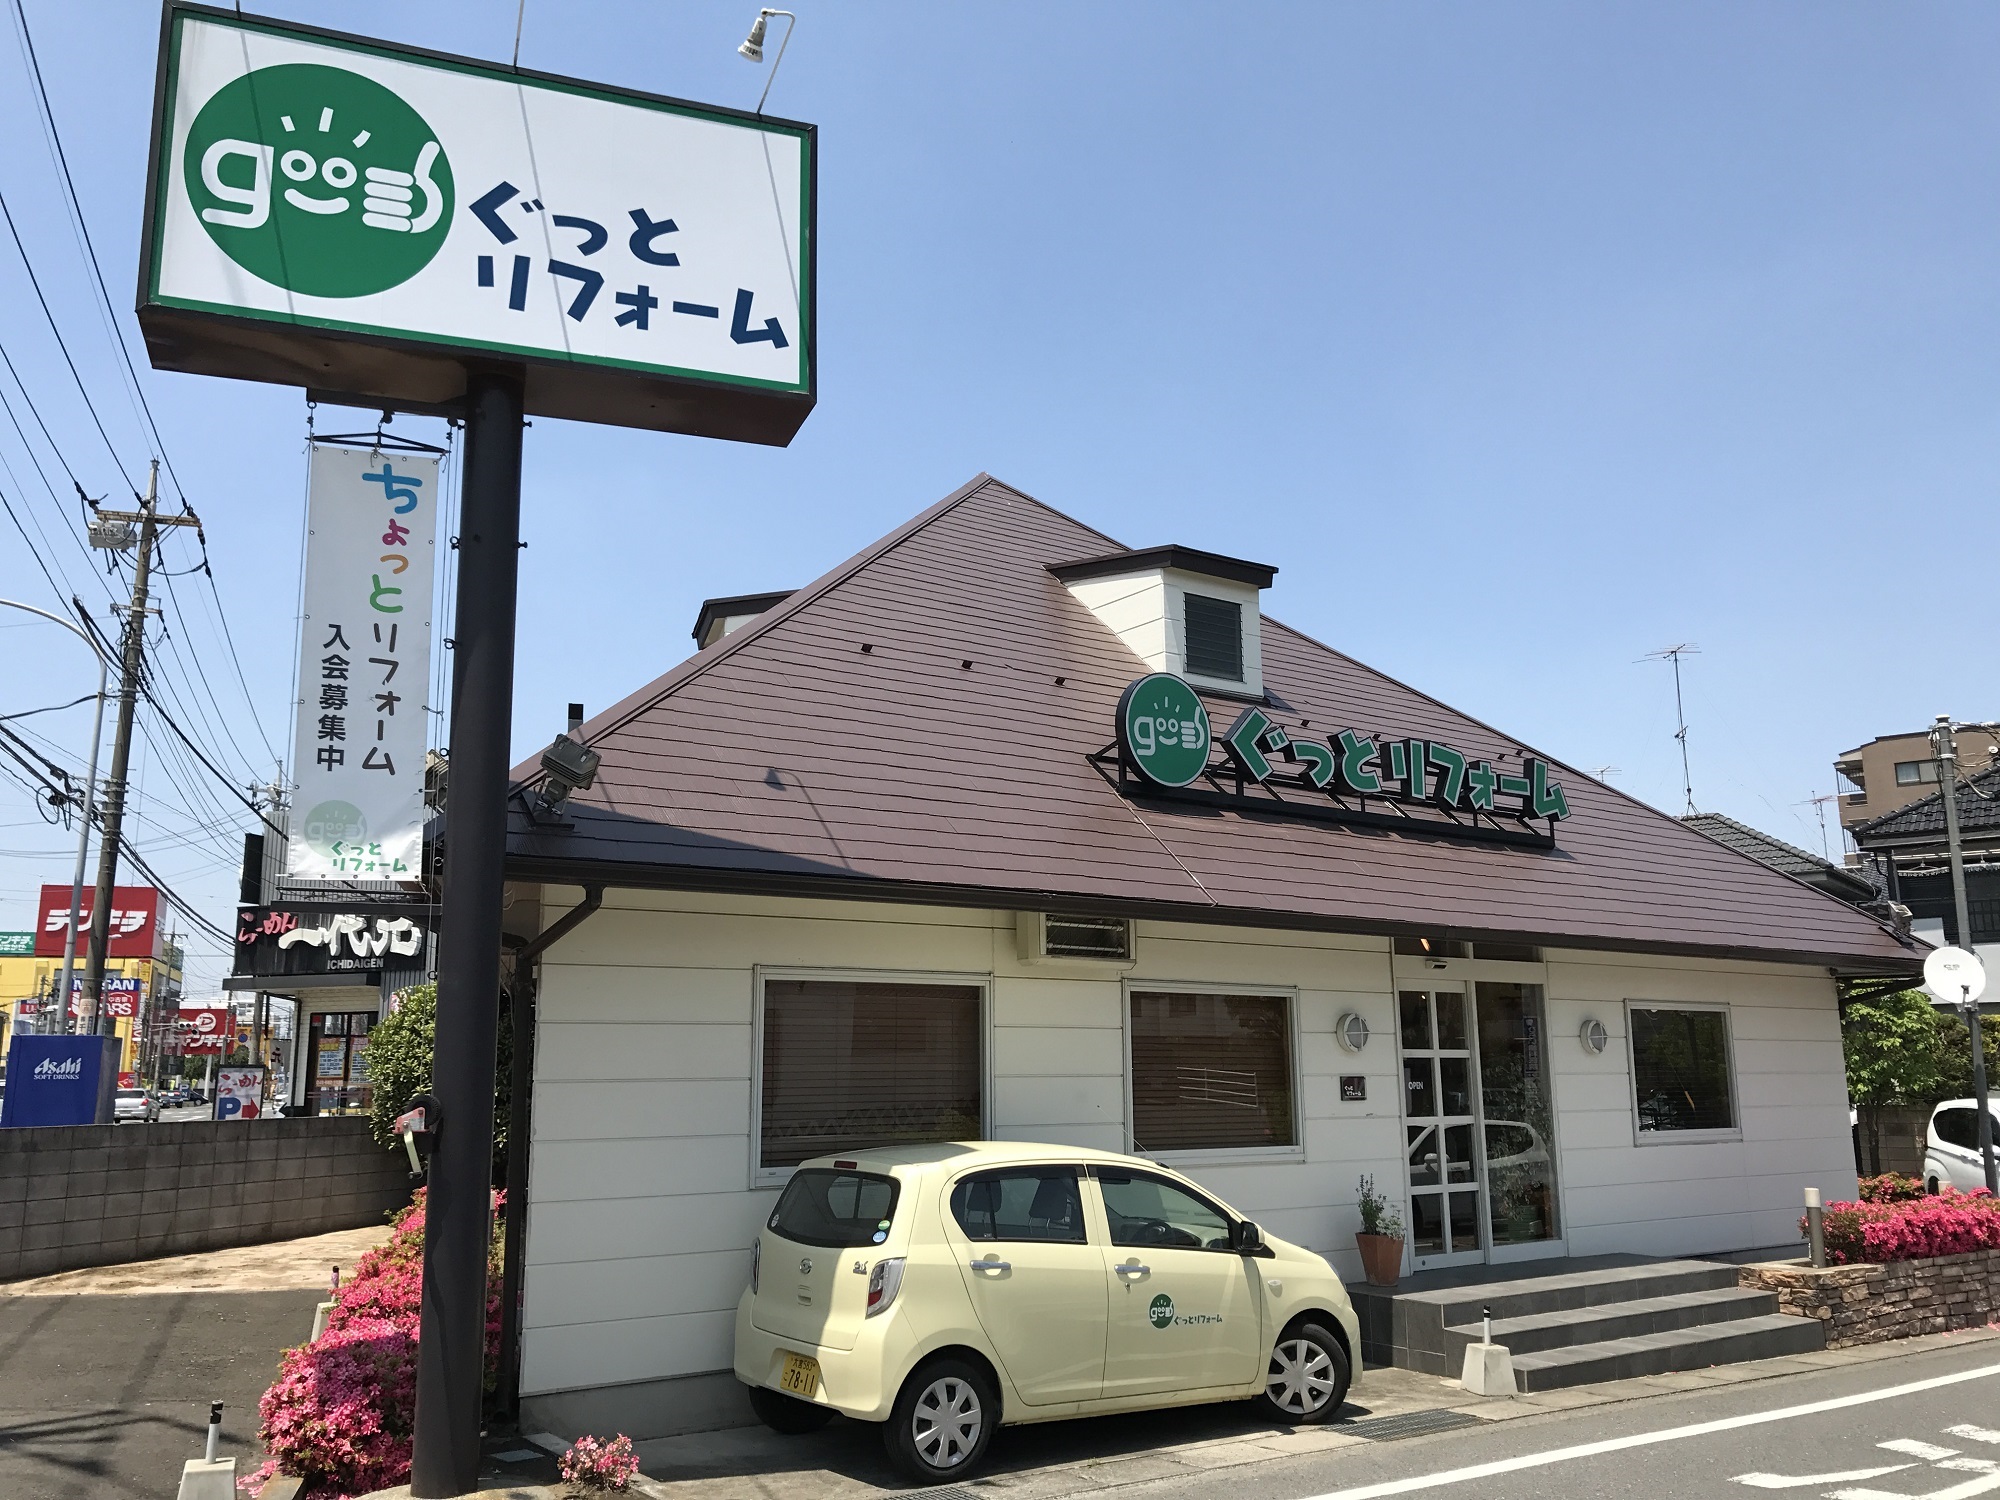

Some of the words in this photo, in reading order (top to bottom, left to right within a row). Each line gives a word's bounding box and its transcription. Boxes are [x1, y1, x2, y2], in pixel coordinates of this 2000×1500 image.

[468, 180, 681, 267] ぐっと
[477, 255, 790, 350] リフォーム
[316, 623, 351, 772] 入会募集中
[1220, 706, 1572, 822] ぐっとリフォーム
[330, 840, 382, 857] ぐっと
[332, 857, 408, 873] リフォーム
[238, 911, 298, 945] らーめん
[328, 958, 384, 969] ICHIDAIGEN
[73, 979, 135, 990] NSAN
[34, 1058, 82, 1074] Asahi
[218, 1074, 263, 1095] らーめん
[1408, 1081, 1424, 1090] OPEN
[217, 1097, 241, 1120] P
[1174, 1314, 1223, 1326] ぐっとリフォーム
